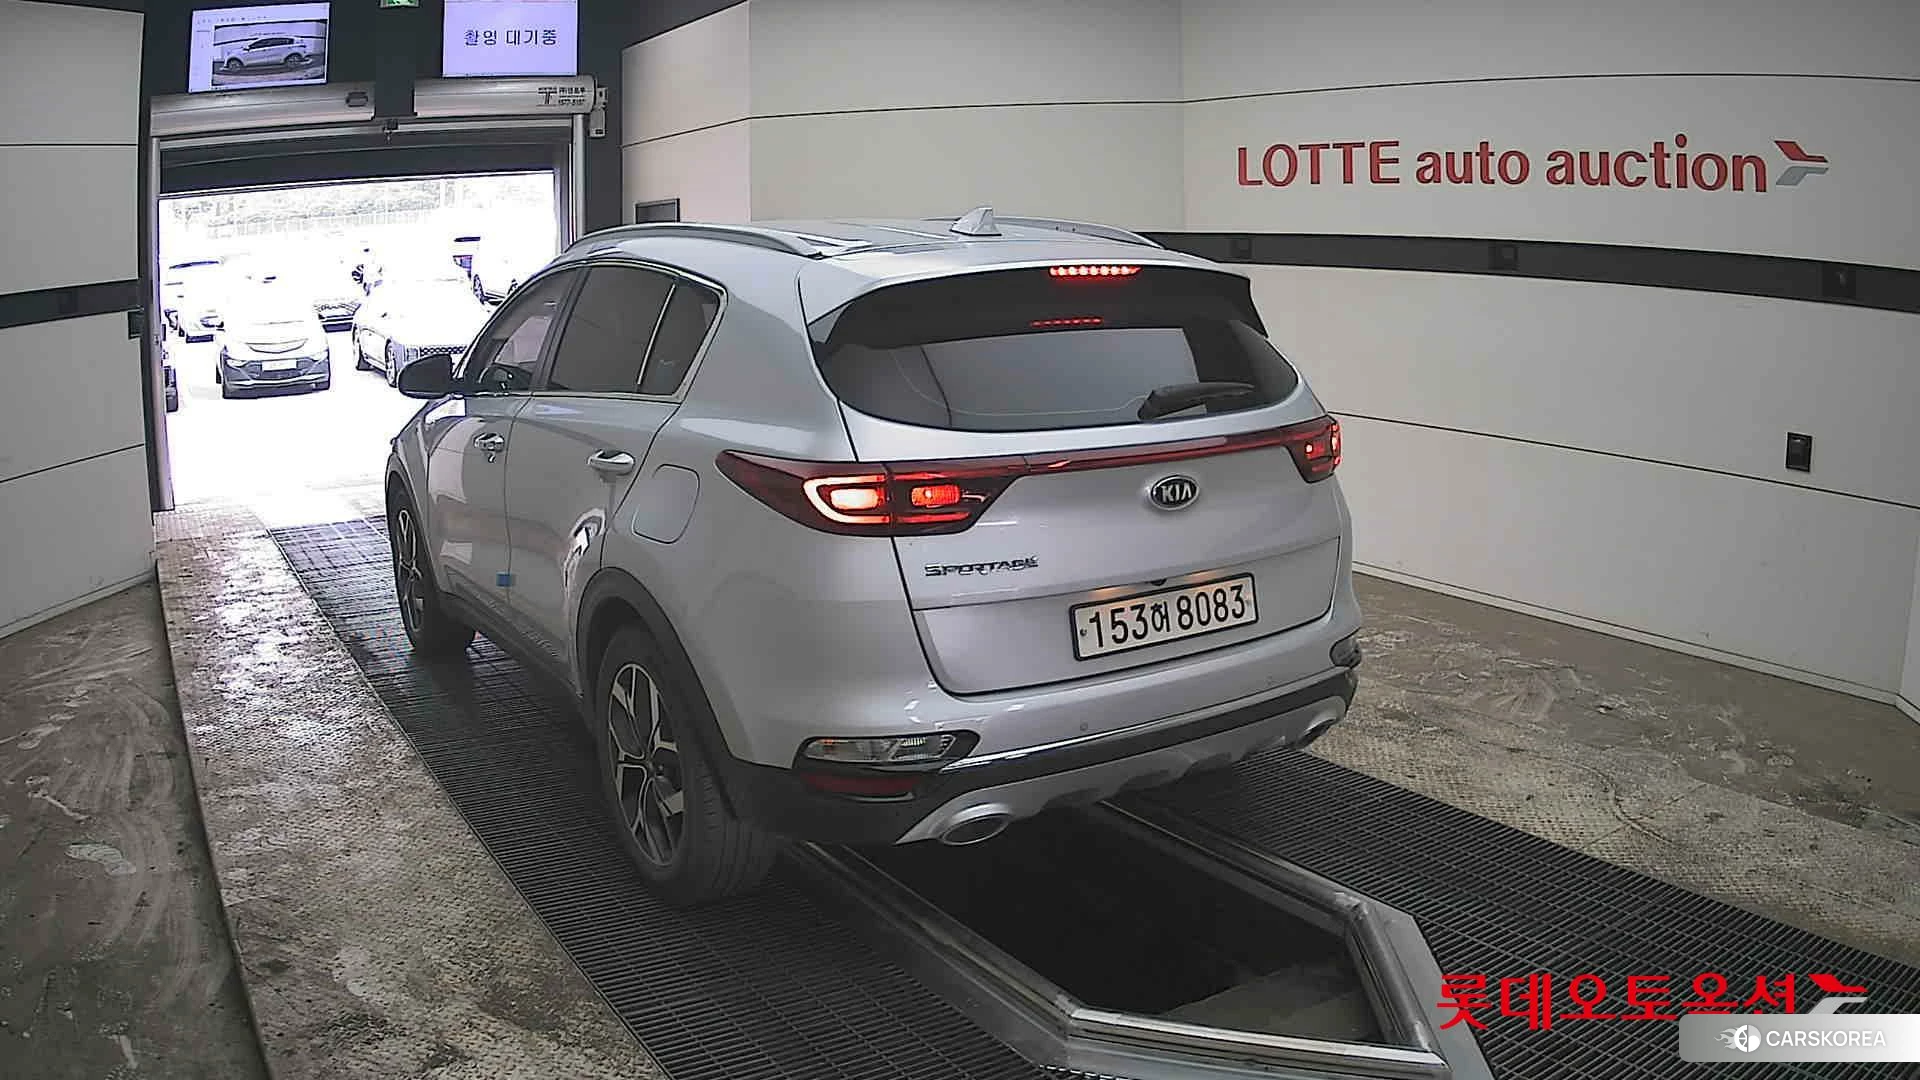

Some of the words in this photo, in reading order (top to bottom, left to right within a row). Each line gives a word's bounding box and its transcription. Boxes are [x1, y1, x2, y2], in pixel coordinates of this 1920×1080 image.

[505, 29, 558, 46] 대기중
[1237, 140, 1400, 187] LOTTE
[1415, 142, 1530, 186] auto
[1546, 134, 1768, 192] auction
[1161, 482, 1192, 502] KIA
[924, 555, 1039, 577] SPORTAGE
[1176, 584, 1246, 631] 8083
